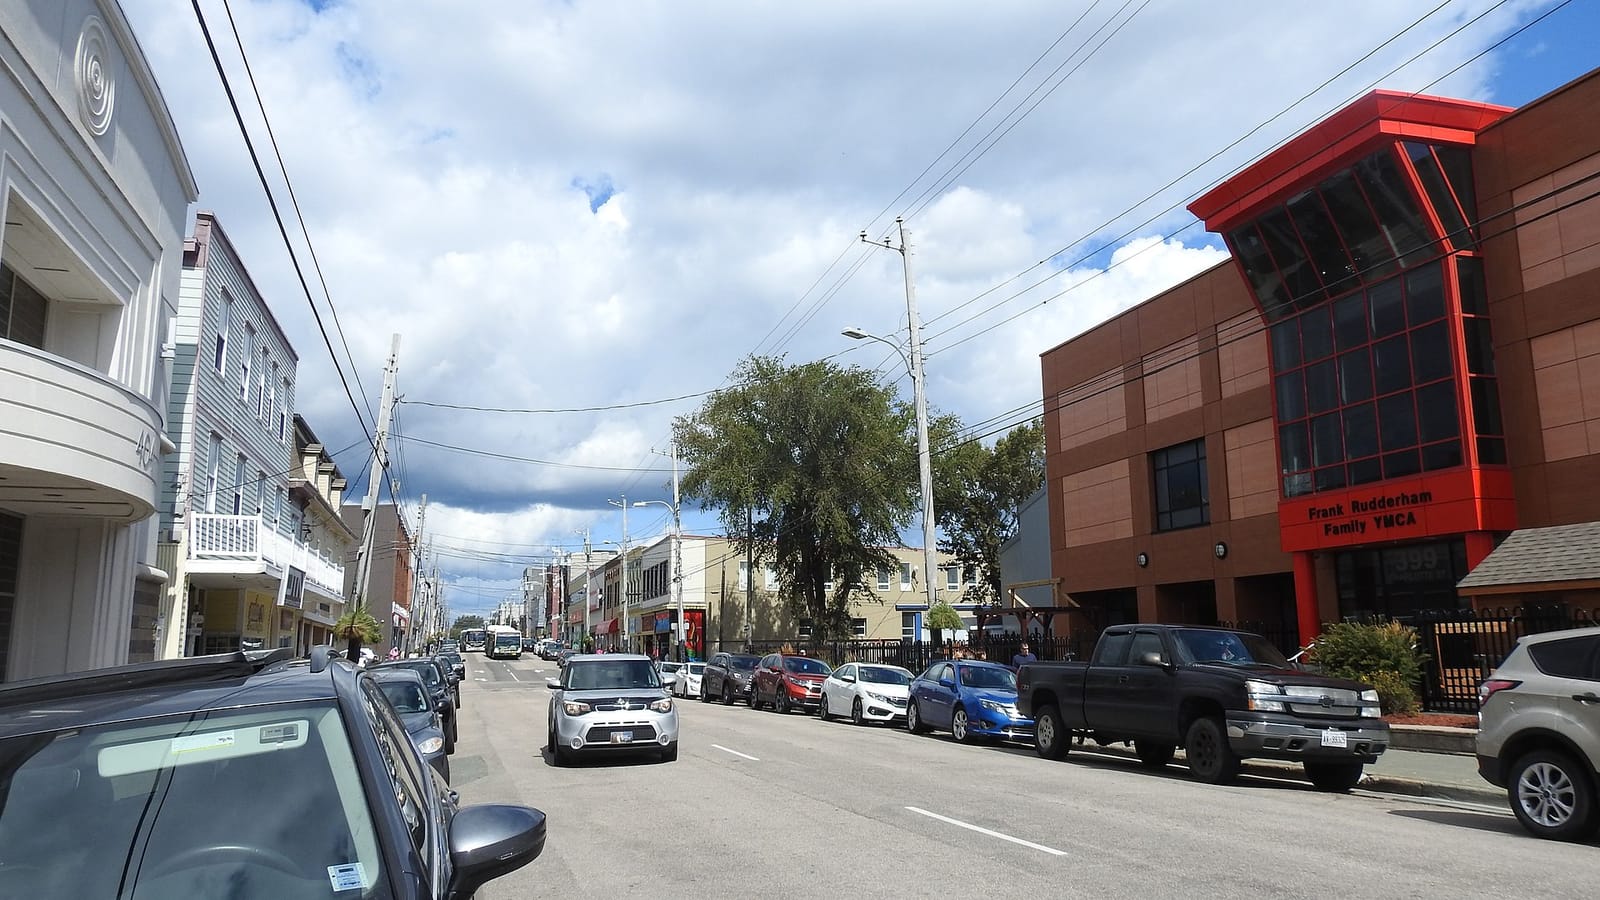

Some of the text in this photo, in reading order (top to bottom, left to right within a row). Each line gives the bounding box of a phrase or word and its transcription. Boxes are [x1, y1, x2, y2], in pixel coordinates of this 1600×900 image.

[1309, 492, 1432, 520] Frank Rudderham
[1324, 512, 1416, 536] Family YMCA
[1394, 547, 1438, 571] 399
